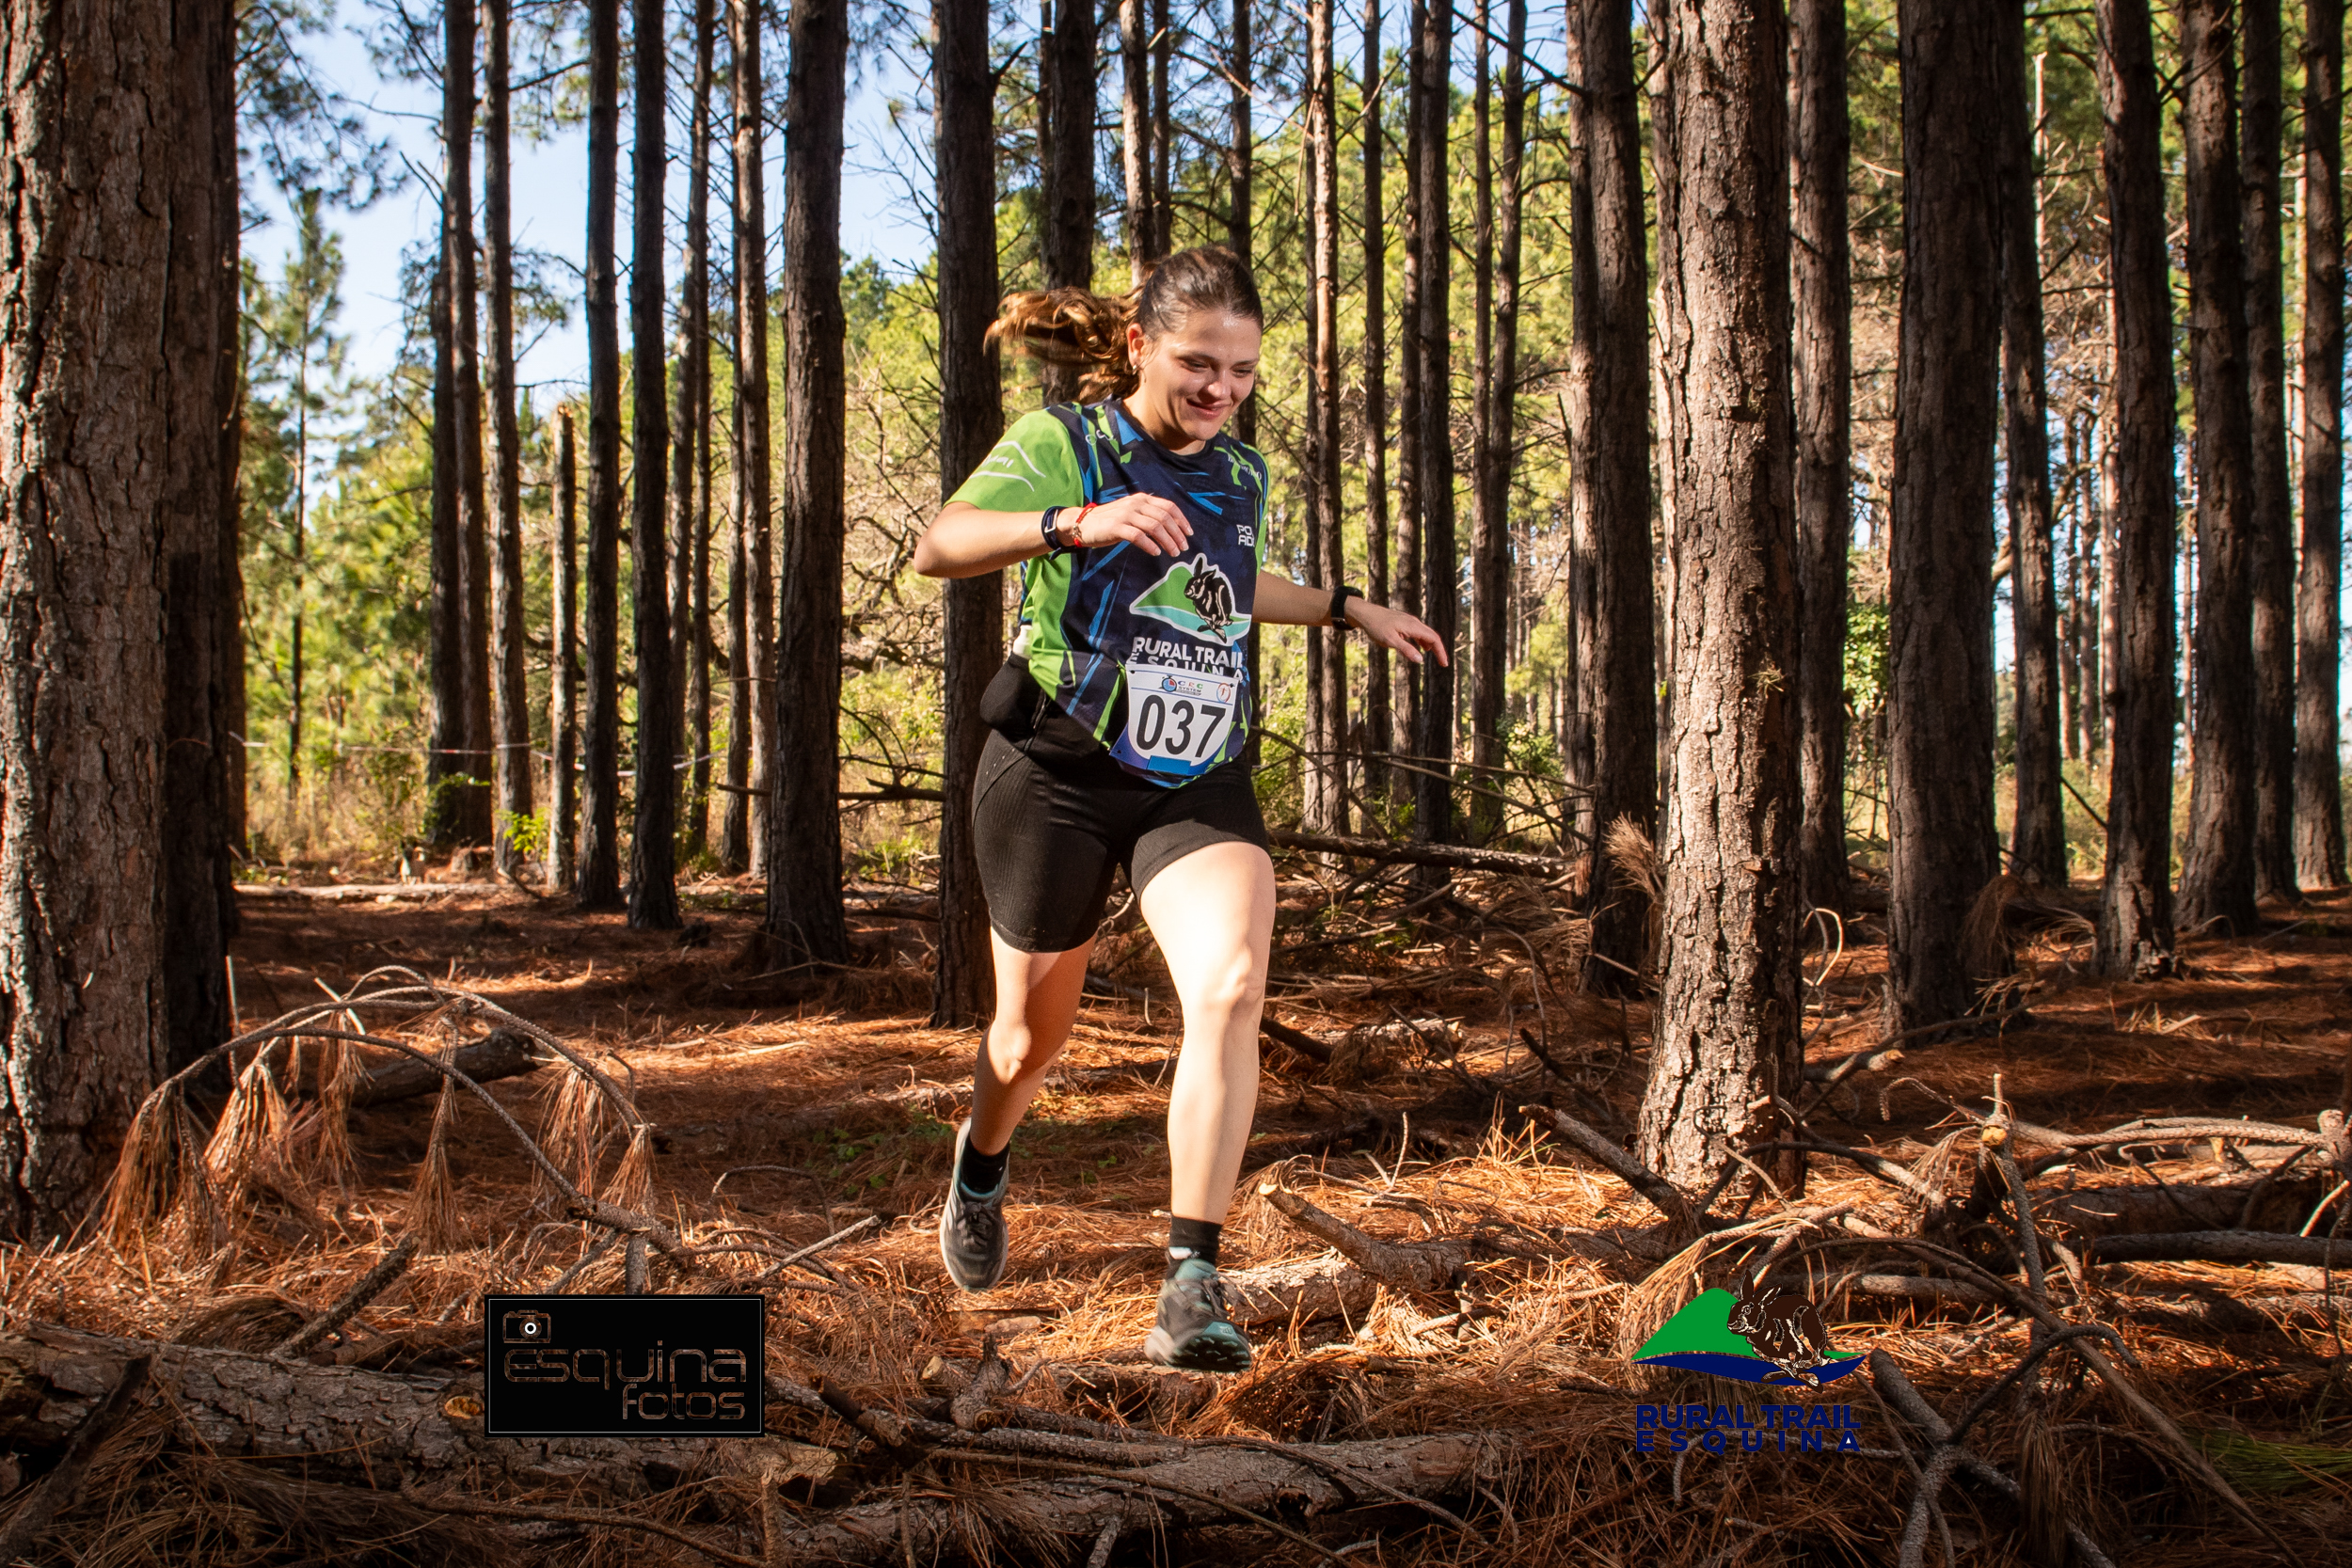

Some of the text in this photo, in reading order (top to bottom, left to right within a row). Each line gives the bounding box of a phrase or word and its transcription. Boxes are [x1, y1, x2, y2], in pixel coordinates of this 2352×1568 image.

[1236, 524, 1254, 538] PO
[1238, 534, 1255, 547] AD
[1132, 637, 1243, 668] RURAL TRAIL
[1136, 694, 1226, 758] 037
